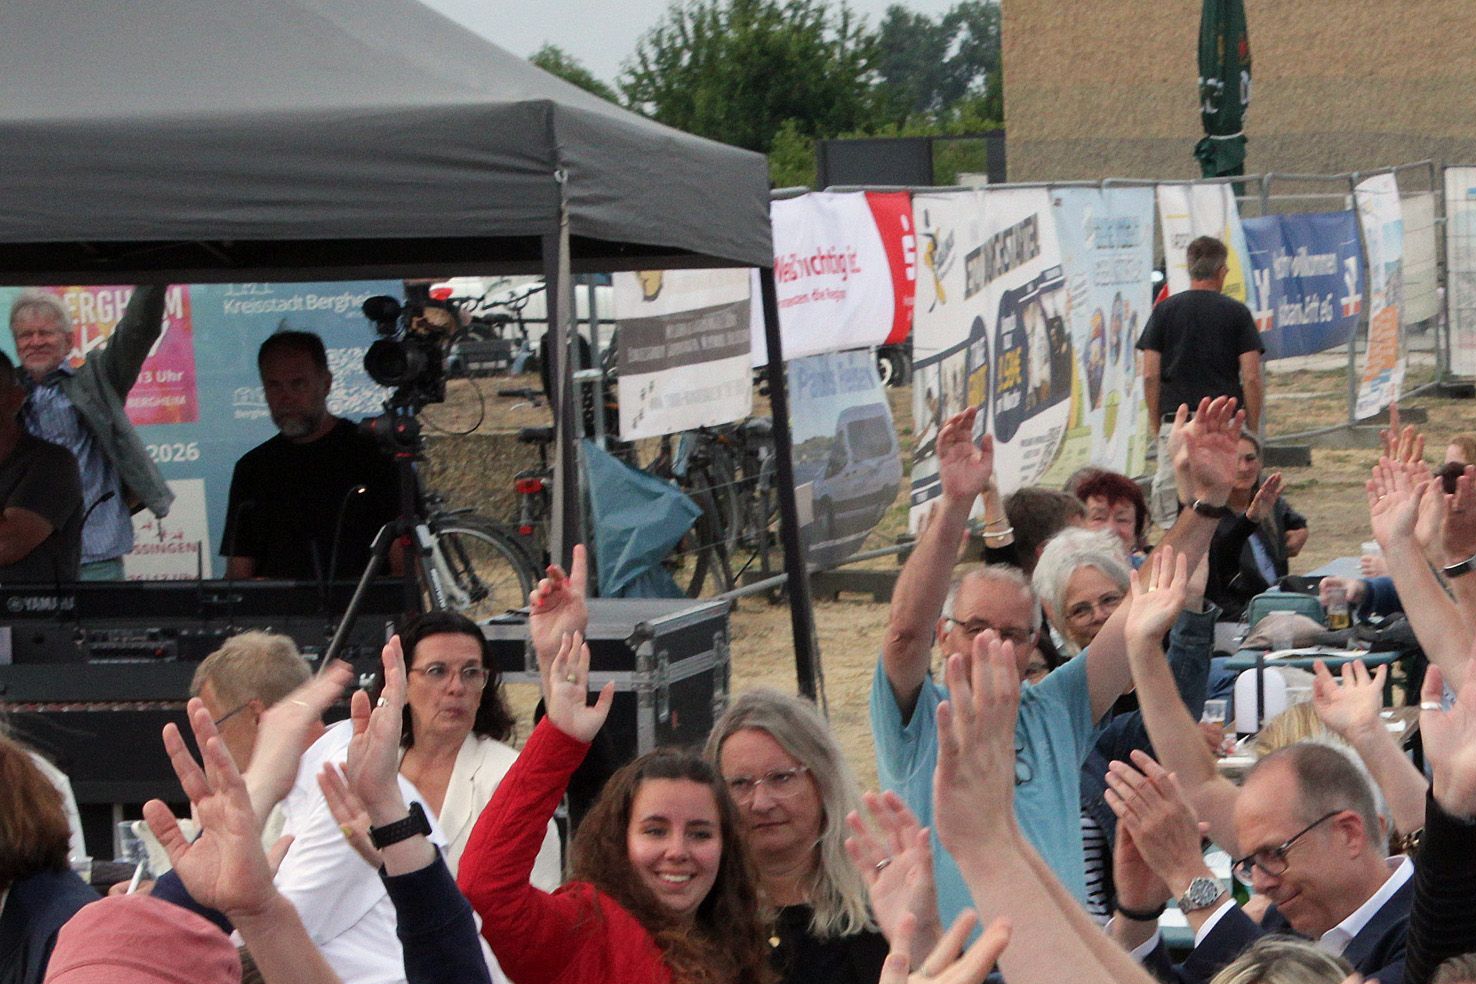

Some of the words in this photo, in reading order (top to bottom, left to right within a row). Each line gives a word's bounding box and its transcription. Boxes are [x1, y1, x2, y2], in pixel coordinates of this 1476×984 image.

[223, 294, 302, 316] Kreisstadt
[155, 369, 185, 384] Uhr
[145, 442, 201, 464] 2026
